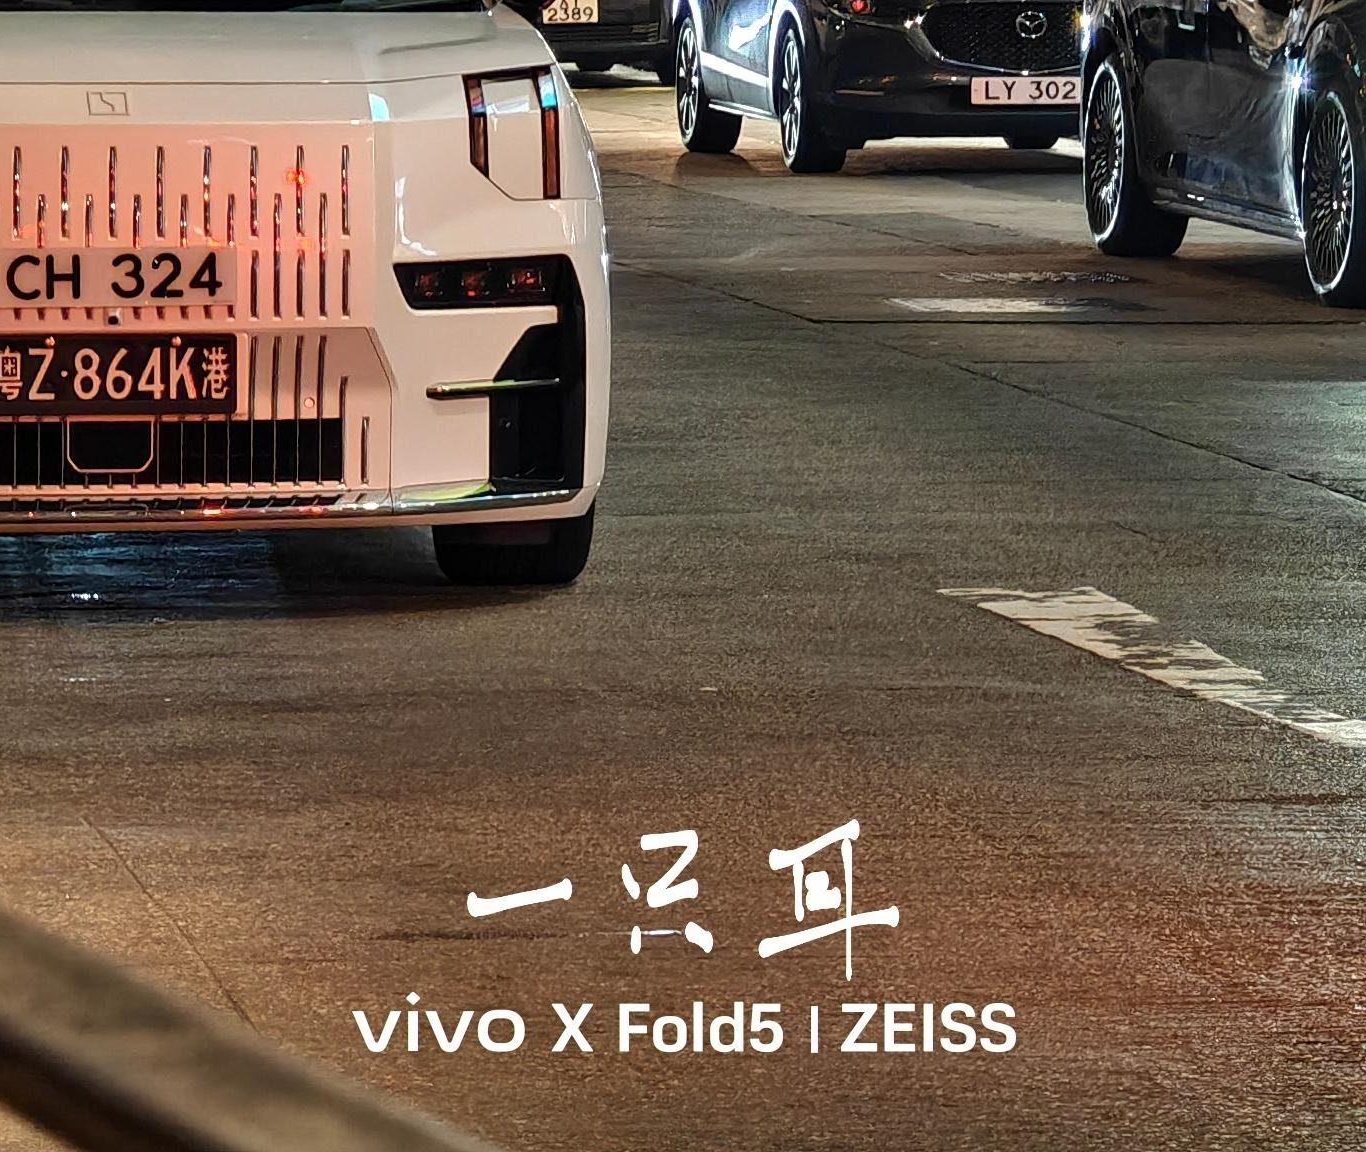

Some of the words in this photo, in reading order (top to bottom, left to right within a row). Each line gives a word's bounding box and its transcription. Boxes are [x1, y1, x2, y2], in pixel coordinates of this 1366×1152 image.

[547, 6, 594, 22] 2389
[985, 80, 1016, 100] LY
[1028, 80, 1077, 100] 302
[6, 254, 81, 300] CH
[111, 252, 223, 299] 324
